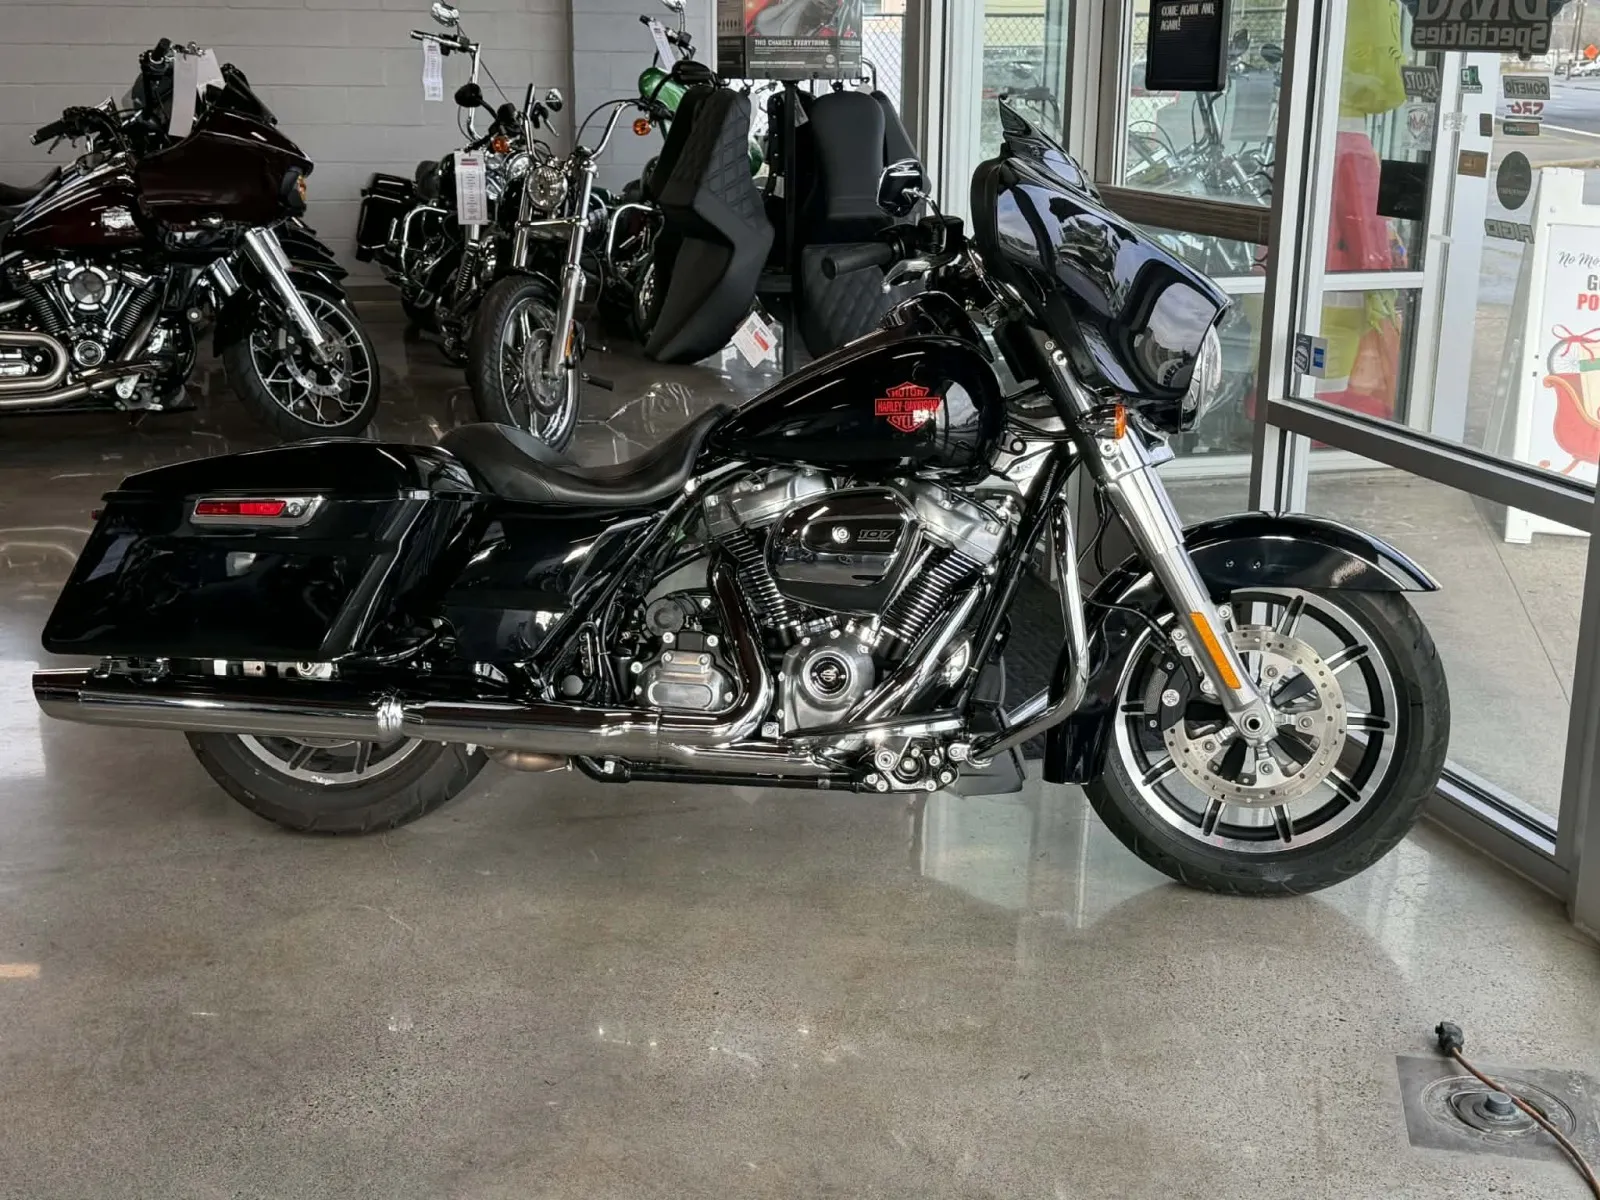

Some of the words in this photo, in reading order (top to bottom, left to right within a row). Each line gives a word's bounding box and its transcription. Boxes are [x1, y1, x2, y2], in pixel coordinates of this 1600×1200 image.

[1180, 3, 1199, 16] AGAIN
[1558, 251, 1576, 268] No
[891, 386, 924, 397] MOTOR
[859, 529, 895, 540] 107
